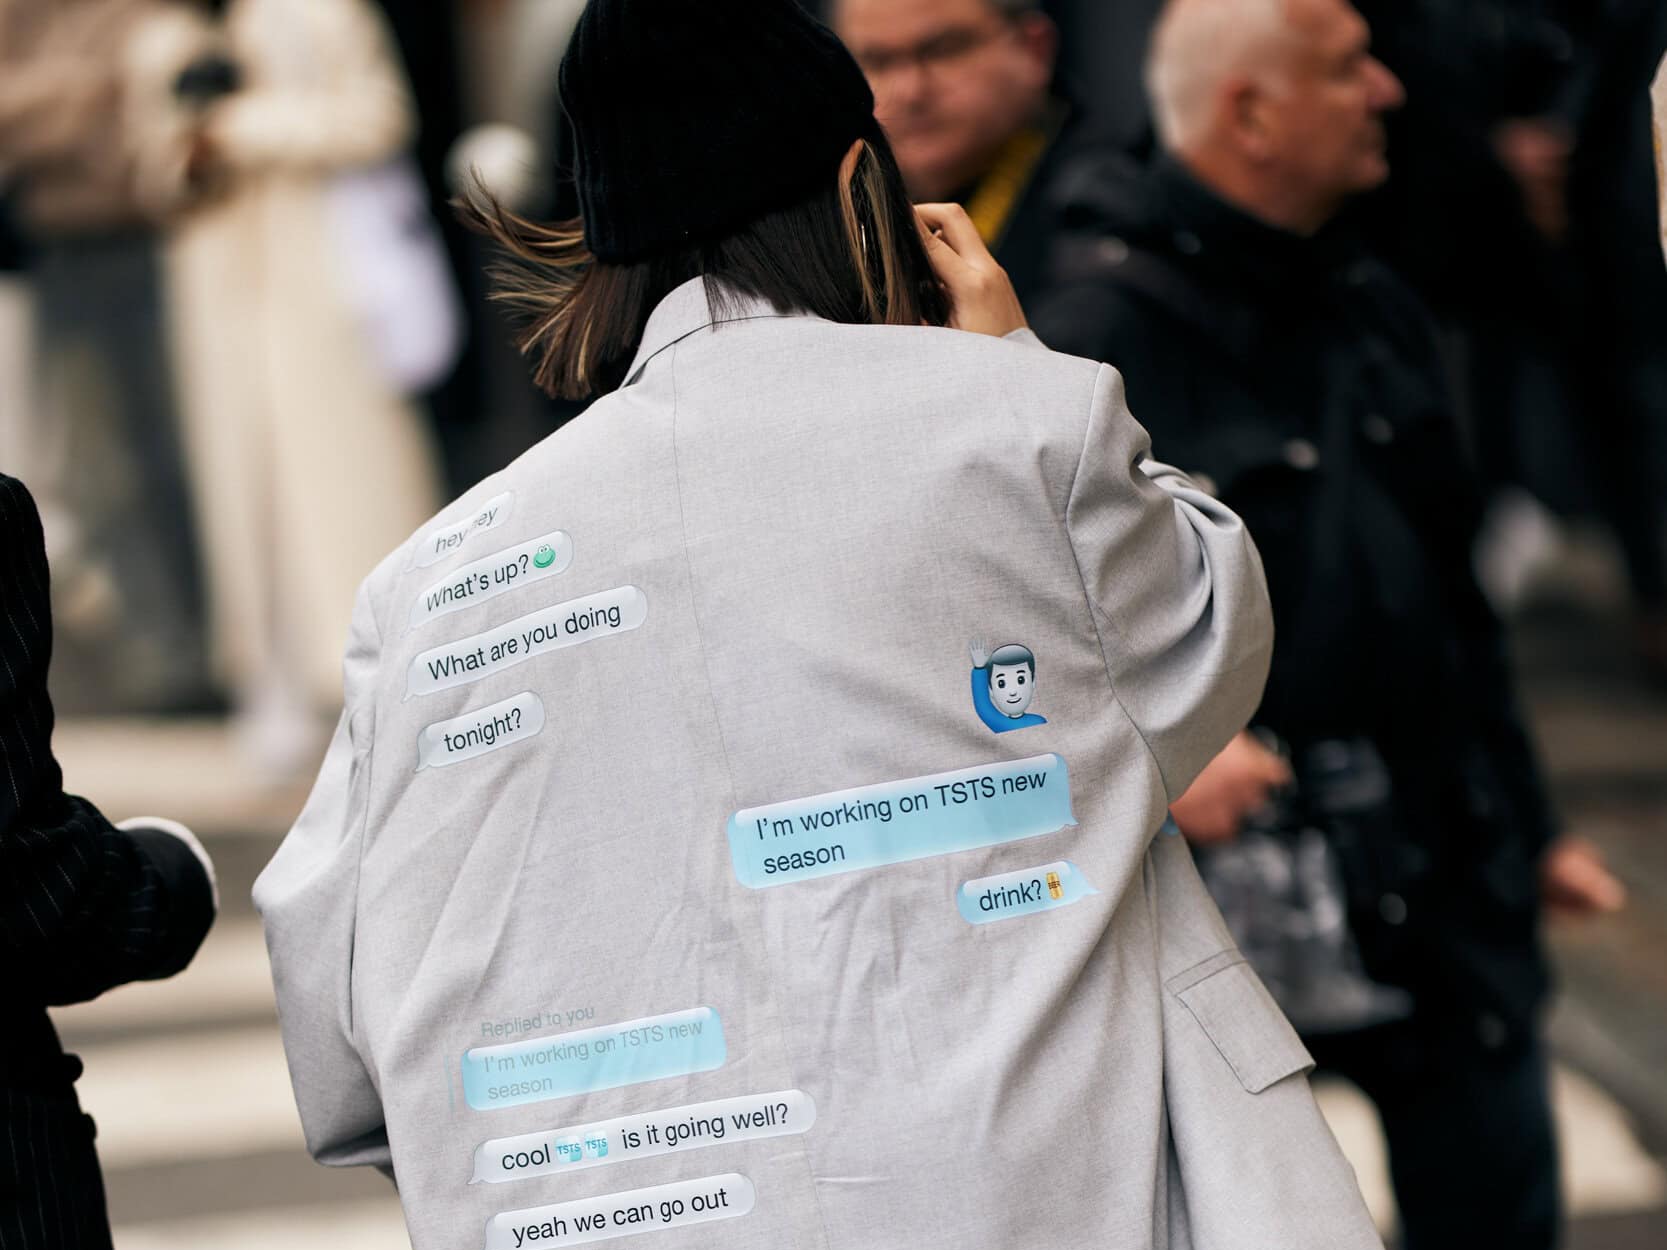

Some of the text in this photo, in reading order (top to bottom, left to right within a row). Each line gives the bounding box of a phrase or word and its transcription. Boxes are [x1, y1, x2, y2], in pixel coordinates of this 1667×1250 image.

[435, 529, 467, 553] hey
[427, 554, 529, 612] What's up?
[427, 605, 621, 681] What are you doing
[444, 708, 521, 752] tonight?
[756, 770, 1047, 840] I'm working on TSTS new
[763, 843, 846, 874] season
[979, 880, 1042, 911] drink?
[481, 1008, 594, 1038] Replied to you
[484, 1020, 703, 1073] I'm working on TSTS new
[487, 1077, 553, 1100] season
[501, 1144, 551, 1171] cool
[622, 1129, 641, 1150] is
[647, 1124, 660, 1145] it
[665, 1115, 724, 1147] going
[731, 1103, 790, 1131] well?
[512, 1187, 729, 1249] yeah we can go out
